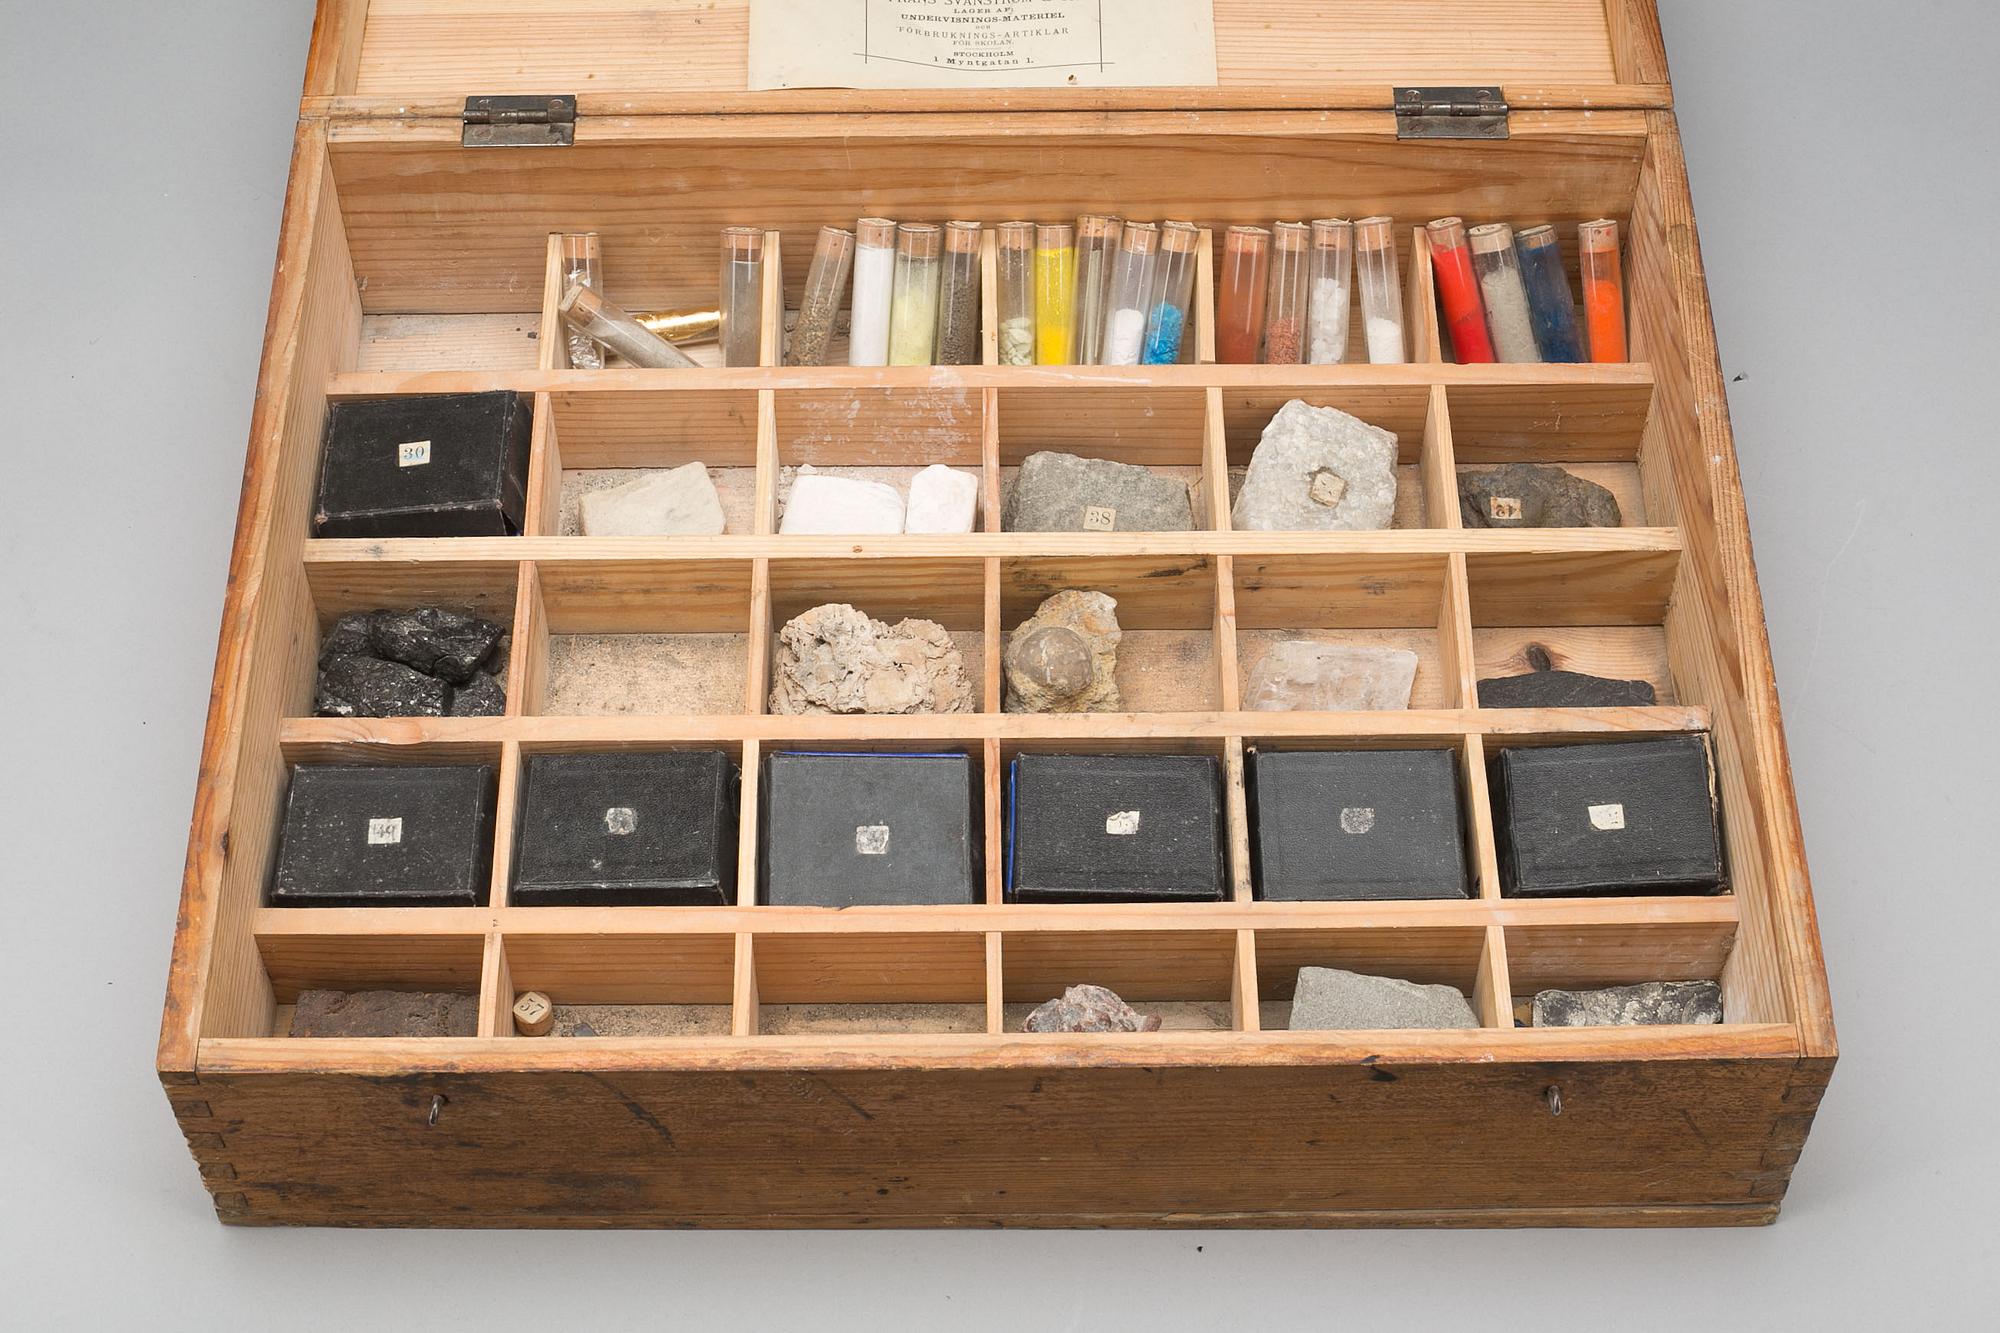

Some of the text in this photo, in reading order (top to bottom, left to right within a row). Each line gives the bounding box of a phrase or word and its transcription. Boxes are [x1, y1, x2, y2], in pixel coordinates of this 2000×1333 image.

[901, 12, 1065, 23] UNDERVISNINGS-MATERIEL
[953, 50, 1014, 58] STOCKHOLM
[946, 58, 1019, 67] Myntgatan
[404, 446, 424, 460] 30
[1090, 511, 1111, 525] 38
[520, 998, 545, 1016] 57
